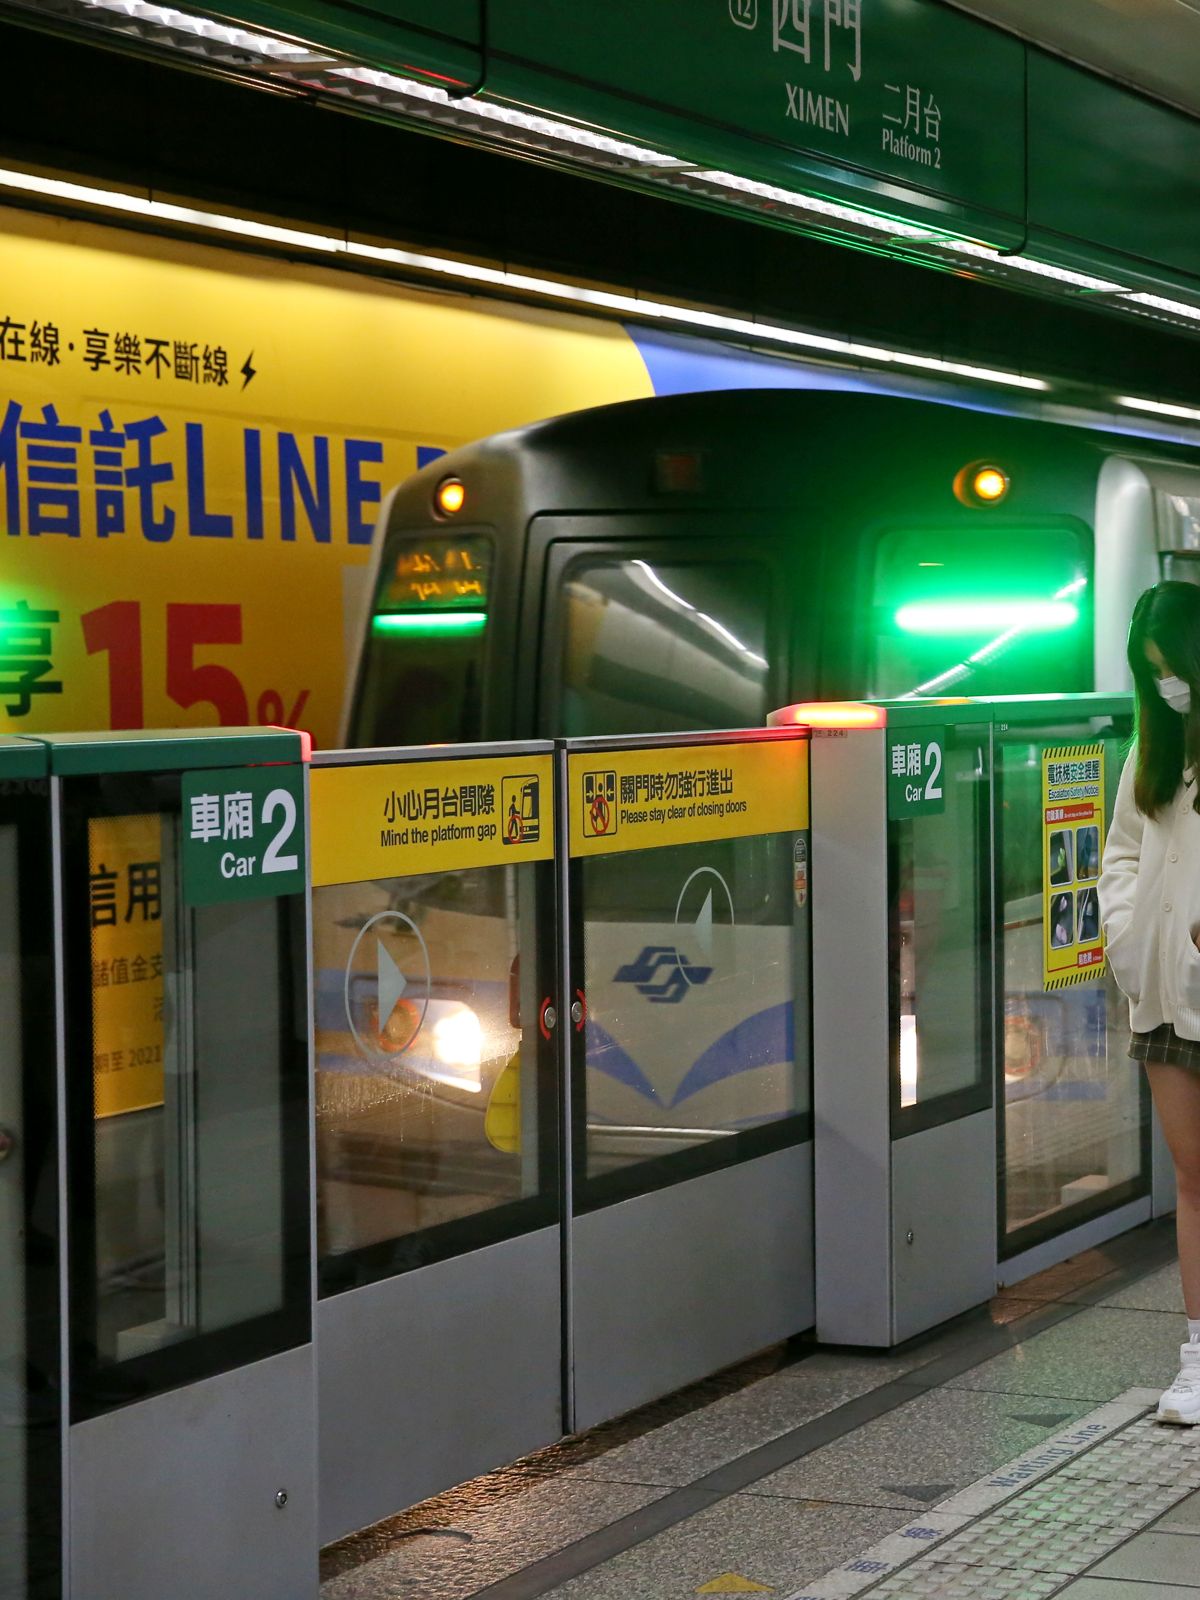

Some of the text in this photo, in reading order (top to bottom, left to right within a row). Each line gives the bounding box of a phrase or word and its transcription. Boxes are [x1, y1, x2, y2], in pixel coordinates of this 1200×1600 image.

[785, 83, 850, 137] XIMEN
[882, 83, 942, 142] 二月台
[882, 128, 941, 169] Platform 2
[620, 768, 733, 804] 關門時勿強行進出
[891, 741, 942, 800] 車廂 2
[383, 784, 495, 823] 小心月台間隙
[620, 800, 747, 824] Please stay clear of closing doors
[905, 783, 922, 803] Car
[190, 788, 298, 874] 車廂 2
[381, 823, 496, 847] Mind the platform gap
[220, 852, 256, 879] Car
[984, 1424, 1107, 1487] Waiting Line
